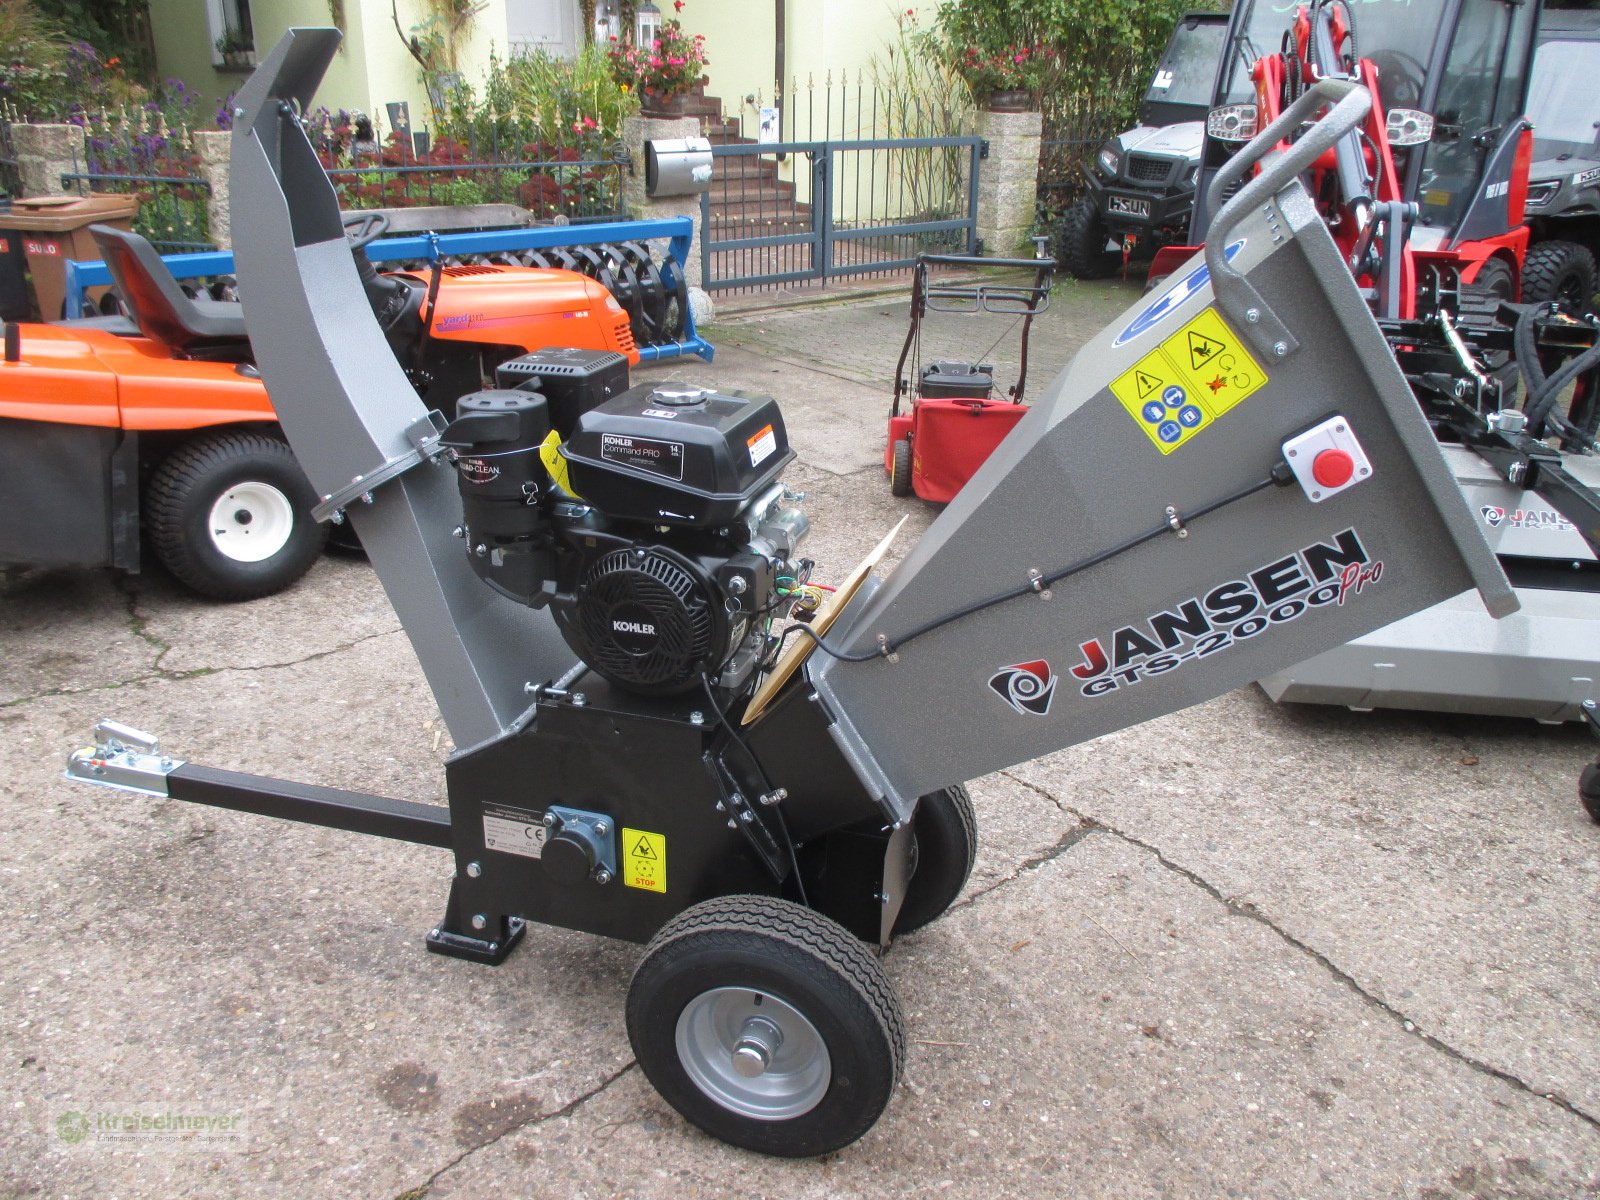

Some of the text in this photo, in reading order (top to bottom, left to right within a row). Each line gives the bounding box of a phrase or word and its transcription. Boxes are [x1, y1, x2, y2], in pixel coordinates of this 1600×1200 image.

[1580, 168, 1600, 183] HSU
[1109, 196, 1150, 217] HSUN
[604, 436, 633, 447] KOHLER
[669, 445, 679, 453] 14
[603, 443, 660, 458] Command PRO
[1069, 526, 1372, 679] JANSEN
[613, 620, 656, 635] KOHLER
[1081, 561, 1384, 697] GTS-2000 Pro
[635, 877, 656, 887] STOP
